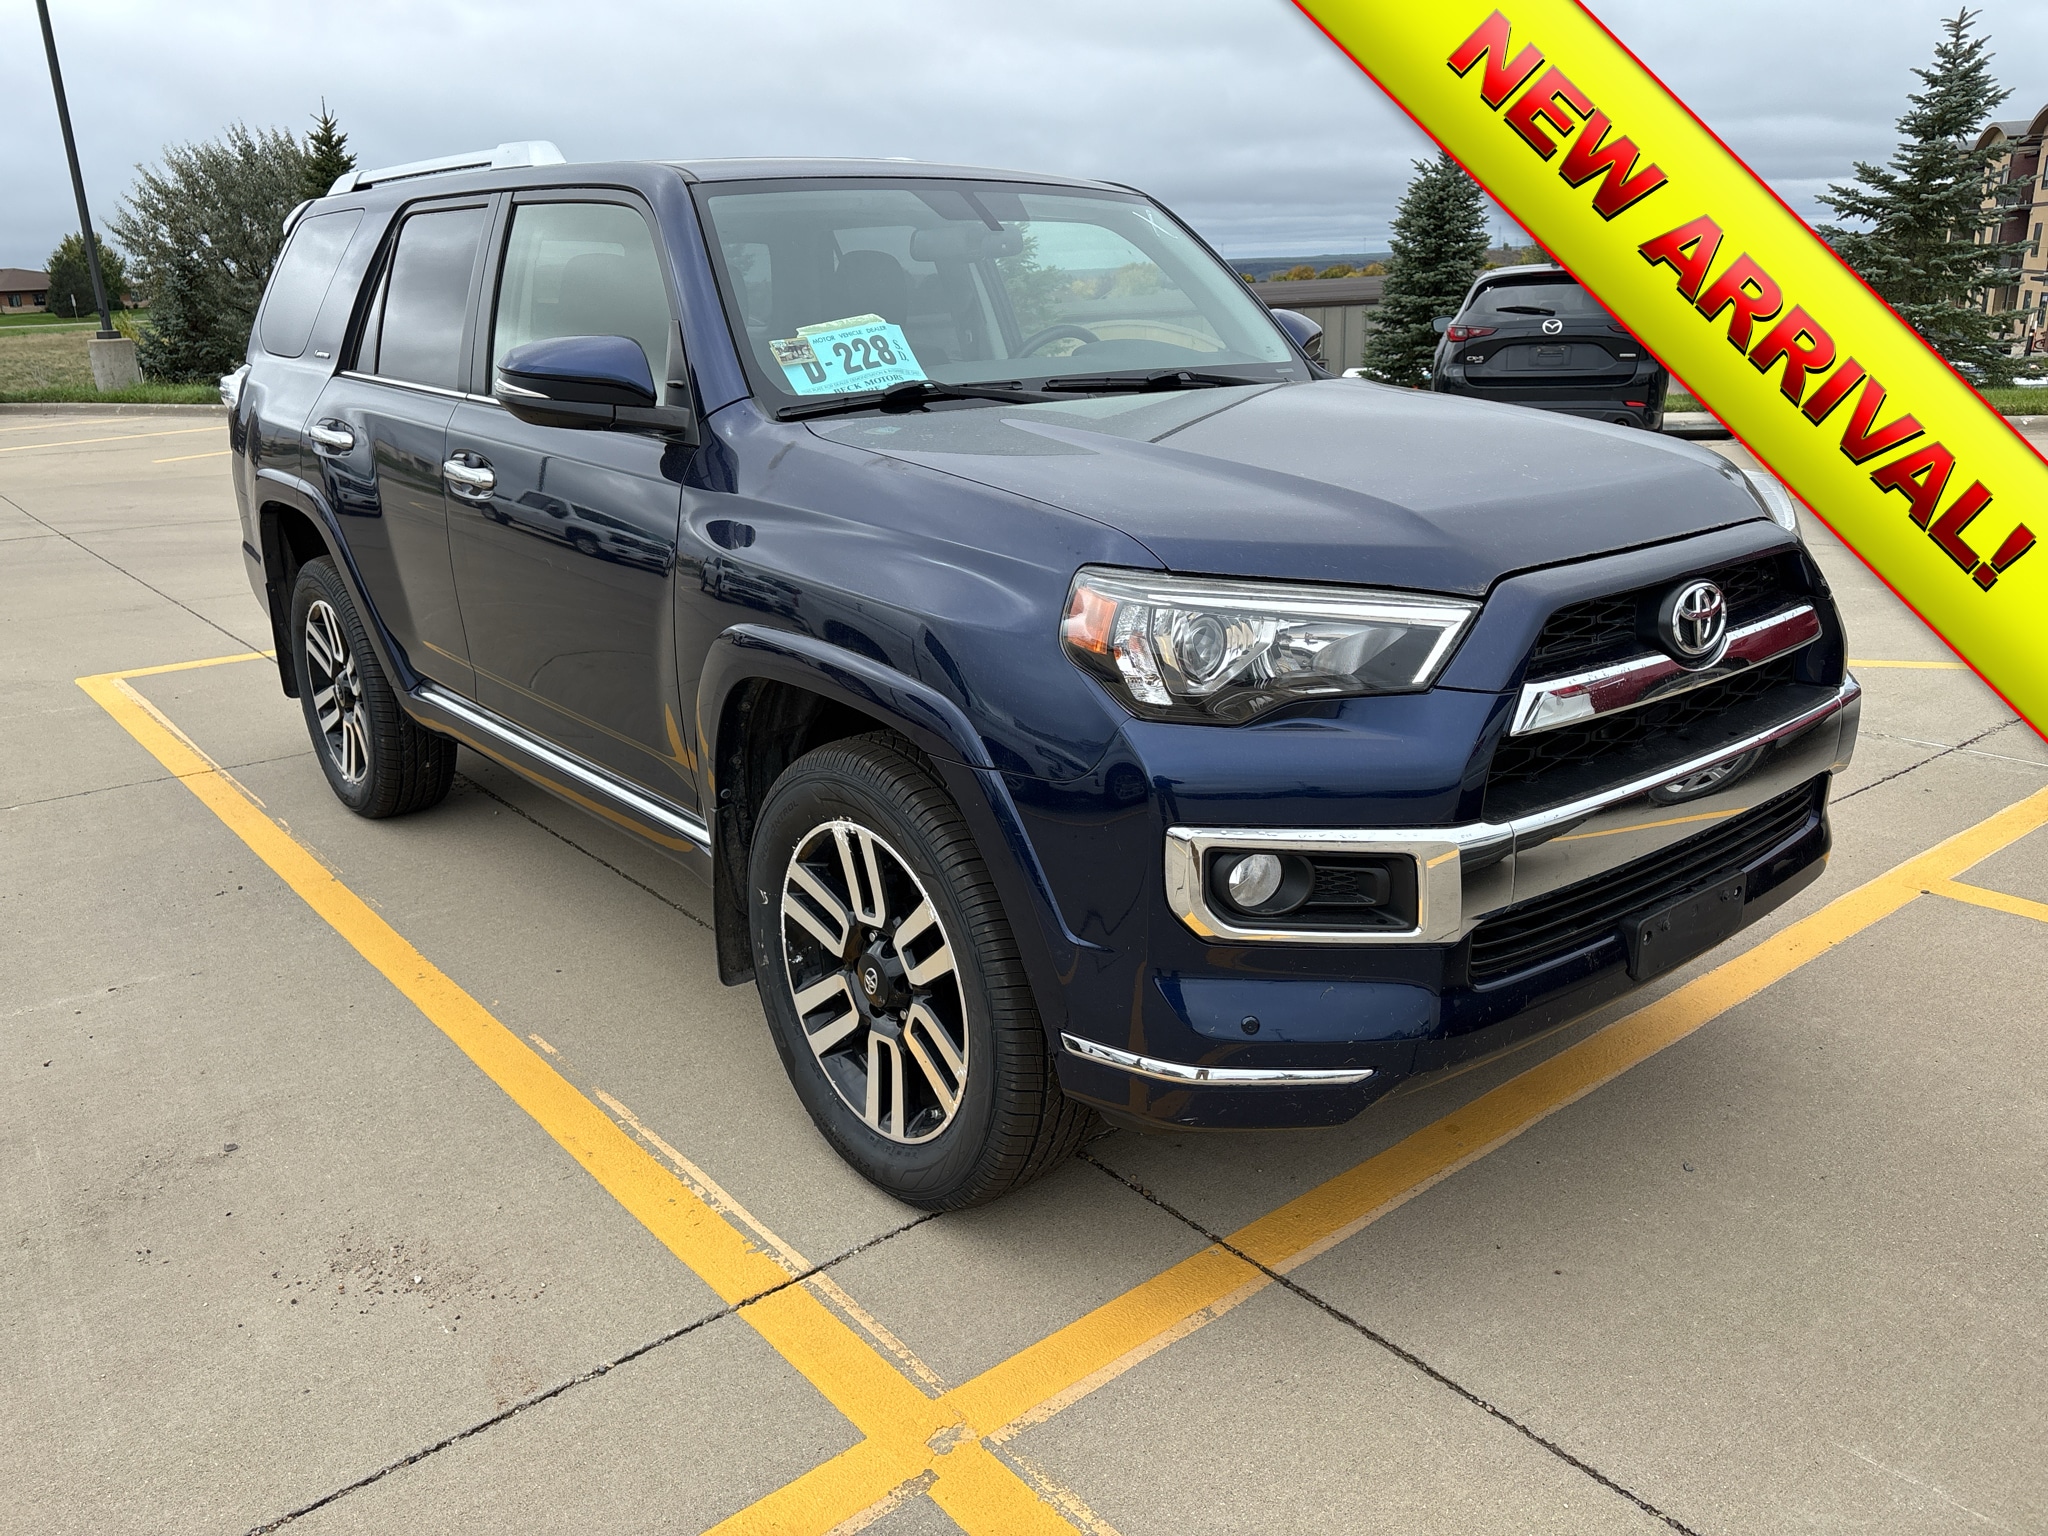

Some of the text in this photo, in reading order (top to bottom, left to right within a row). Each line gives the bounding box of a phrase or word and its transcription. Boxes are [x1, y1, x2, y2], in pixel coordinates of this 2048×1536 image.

[812, 325, 887, 345] MOTOR VEHICLE DEALER
[864, 374, 905, 387] MOTORS
